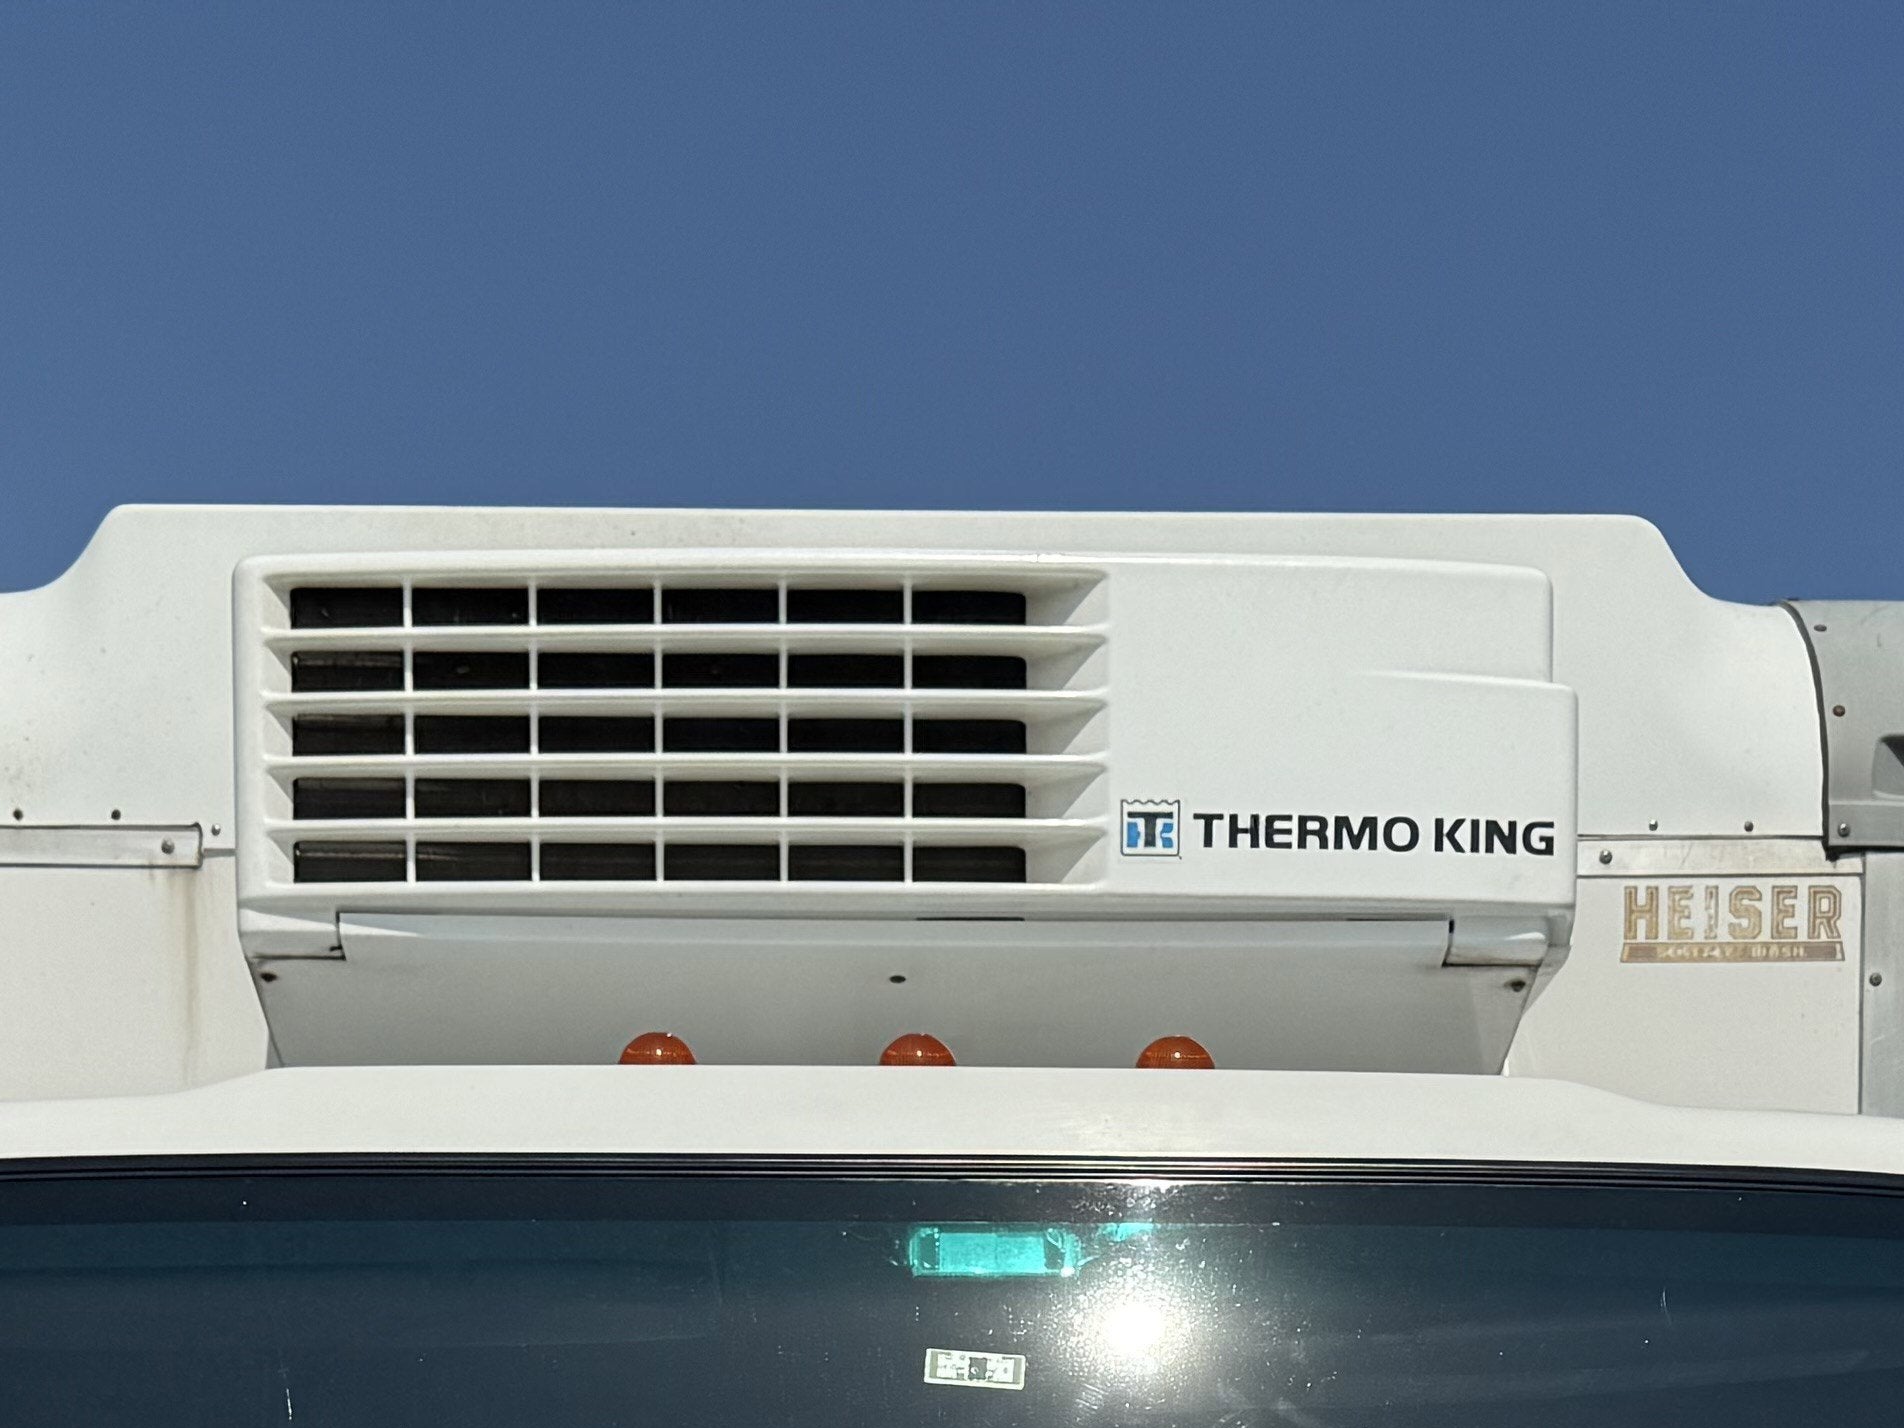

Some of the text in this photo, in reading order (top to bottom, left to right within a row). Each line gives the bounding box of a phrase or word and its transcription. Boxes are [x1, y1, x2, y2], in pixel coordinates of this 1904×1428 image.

[1192, 811, 1555, 857] THERMO KING
[1623, 885, 1842, 940] HEISER
